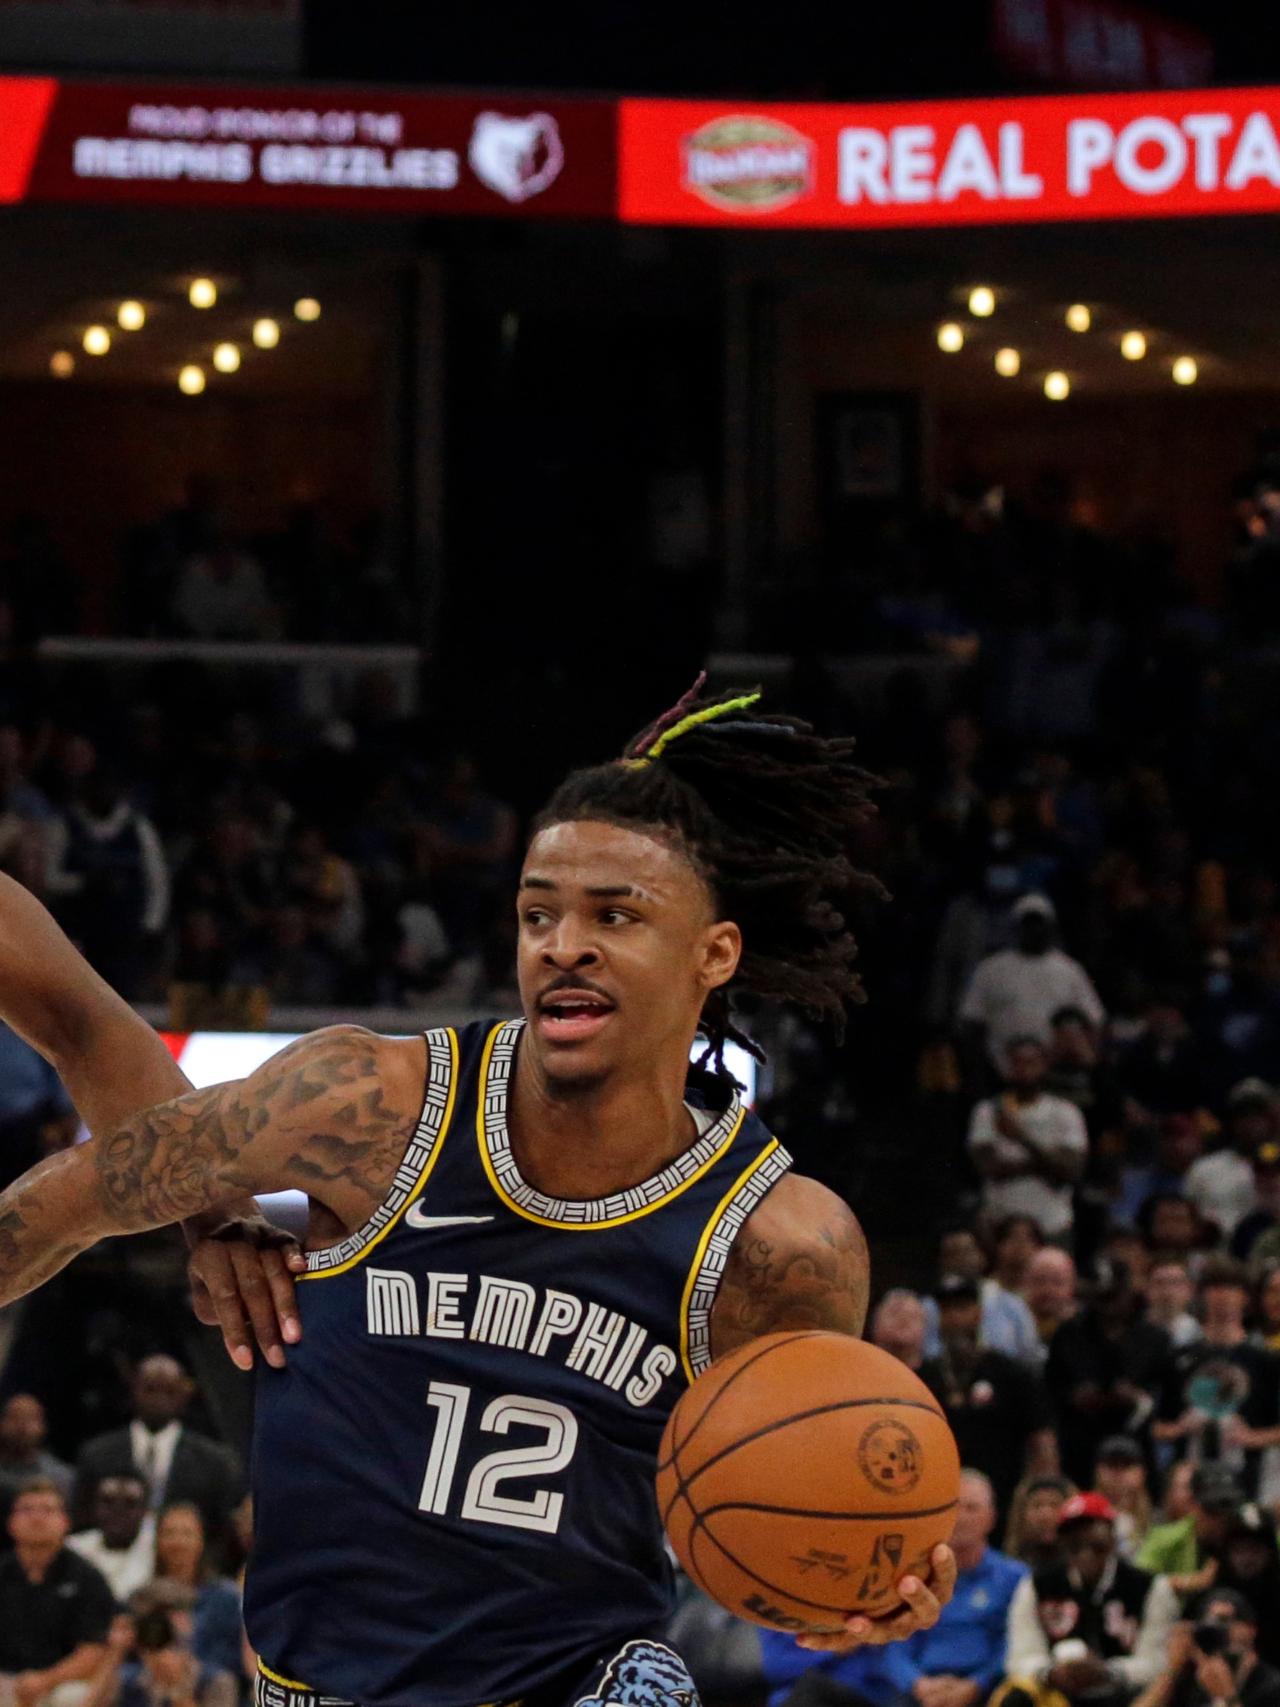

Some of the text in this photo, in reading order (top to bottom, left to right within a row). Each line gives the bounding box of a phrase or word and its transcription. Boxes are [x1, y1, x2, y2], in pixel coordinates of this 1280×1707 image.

[837, 122, 1043, 205] REAL
[366, 1266, 677, 1408] MEMPHIS
[418, 1380, 579, 1535] 12
